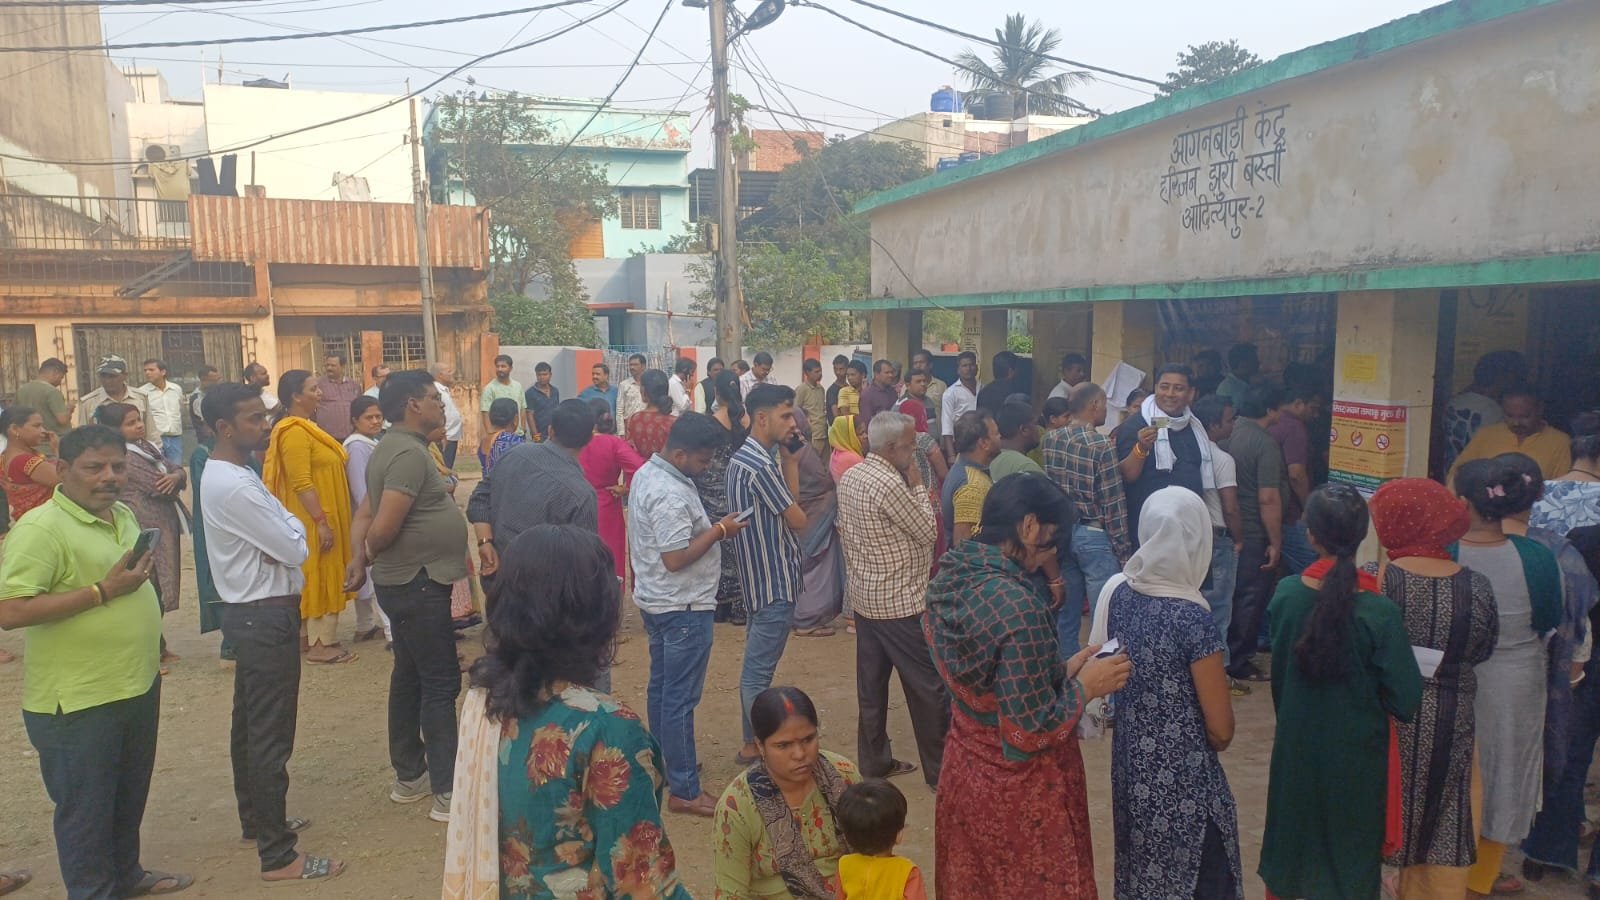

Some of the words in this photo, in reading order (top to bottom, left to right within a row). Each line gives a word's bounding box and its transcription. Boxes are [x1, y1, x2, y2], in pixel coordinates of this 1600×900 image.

[1159, 166, 1200, 204] हरिजन
[1243, 143, 1286, 188] बस्ती
[1183, 194, 1264, 239] आदित्यपुर-2
